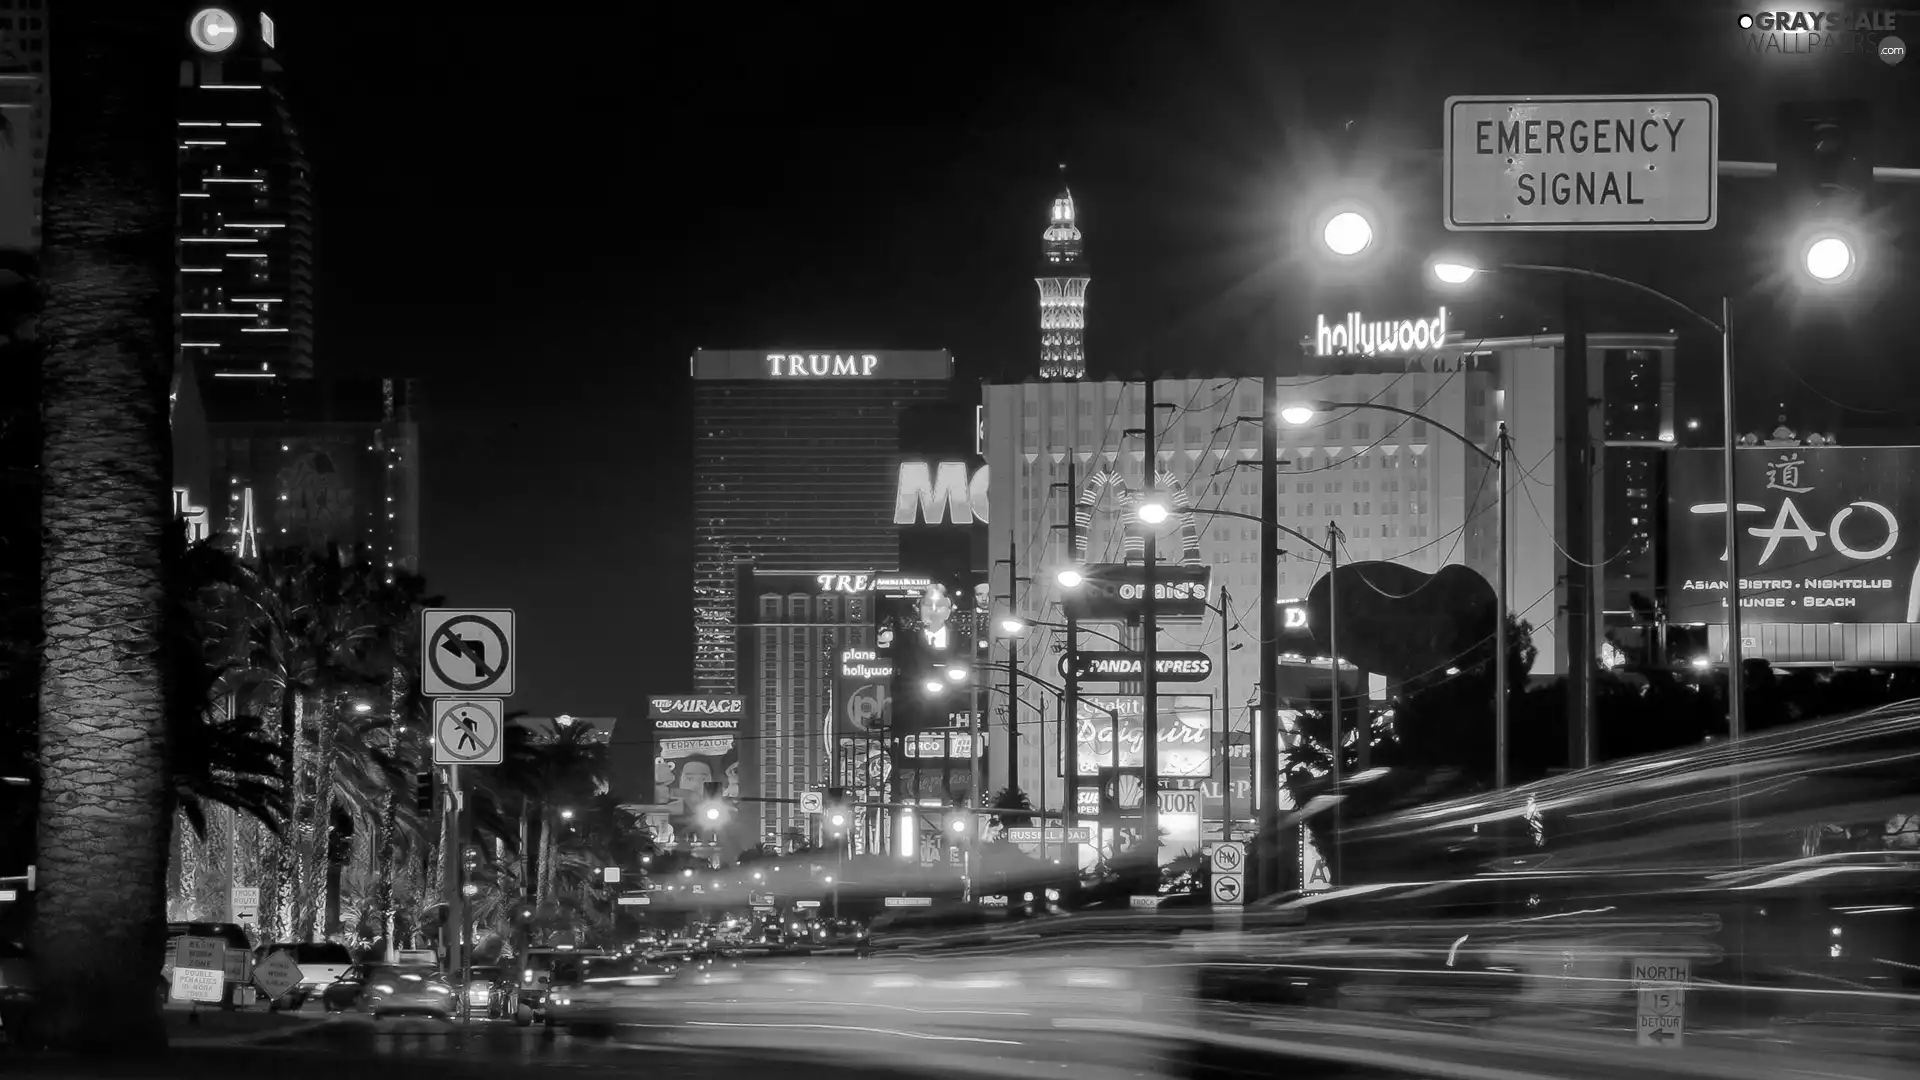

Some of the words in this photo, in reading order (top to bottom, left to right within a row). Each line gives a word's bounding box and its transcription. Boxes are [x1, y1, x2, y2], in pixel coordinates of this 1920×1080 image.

[1476, 118, 1686, 155] EMERGENCY
[1516, 171, 1644, 206] SIGNAL
[1316, 305, 1447, 356] hollywood
[766, 353, 878, 376] TRUMP
[1766, 452, 1815, 494] 道
[1689, 496, 1899, 566] TAO
[1804, 578, 1893, 590] NIGHTCLUB
[1722, 596, 1786, 608] LUNGE
[1803, 596, 1856, 608] BEACH
[843, 648, 881, 663] plane
[1089, 659, 1142, 673] PANDA
[1154, 659, 1210, 673] XPRESS
[672, 699, 742, 714] MIRAGE
[655, 720, 691, 728] CASINO
[692, 720, 700, 728] &
[701, 720, 739, 728] RESORT
[1636, 965, 1686, 980] NORTH
[1654, 994, 1670, 1008] 15
[1641, 1016, 1680, 1028] DETOUR
